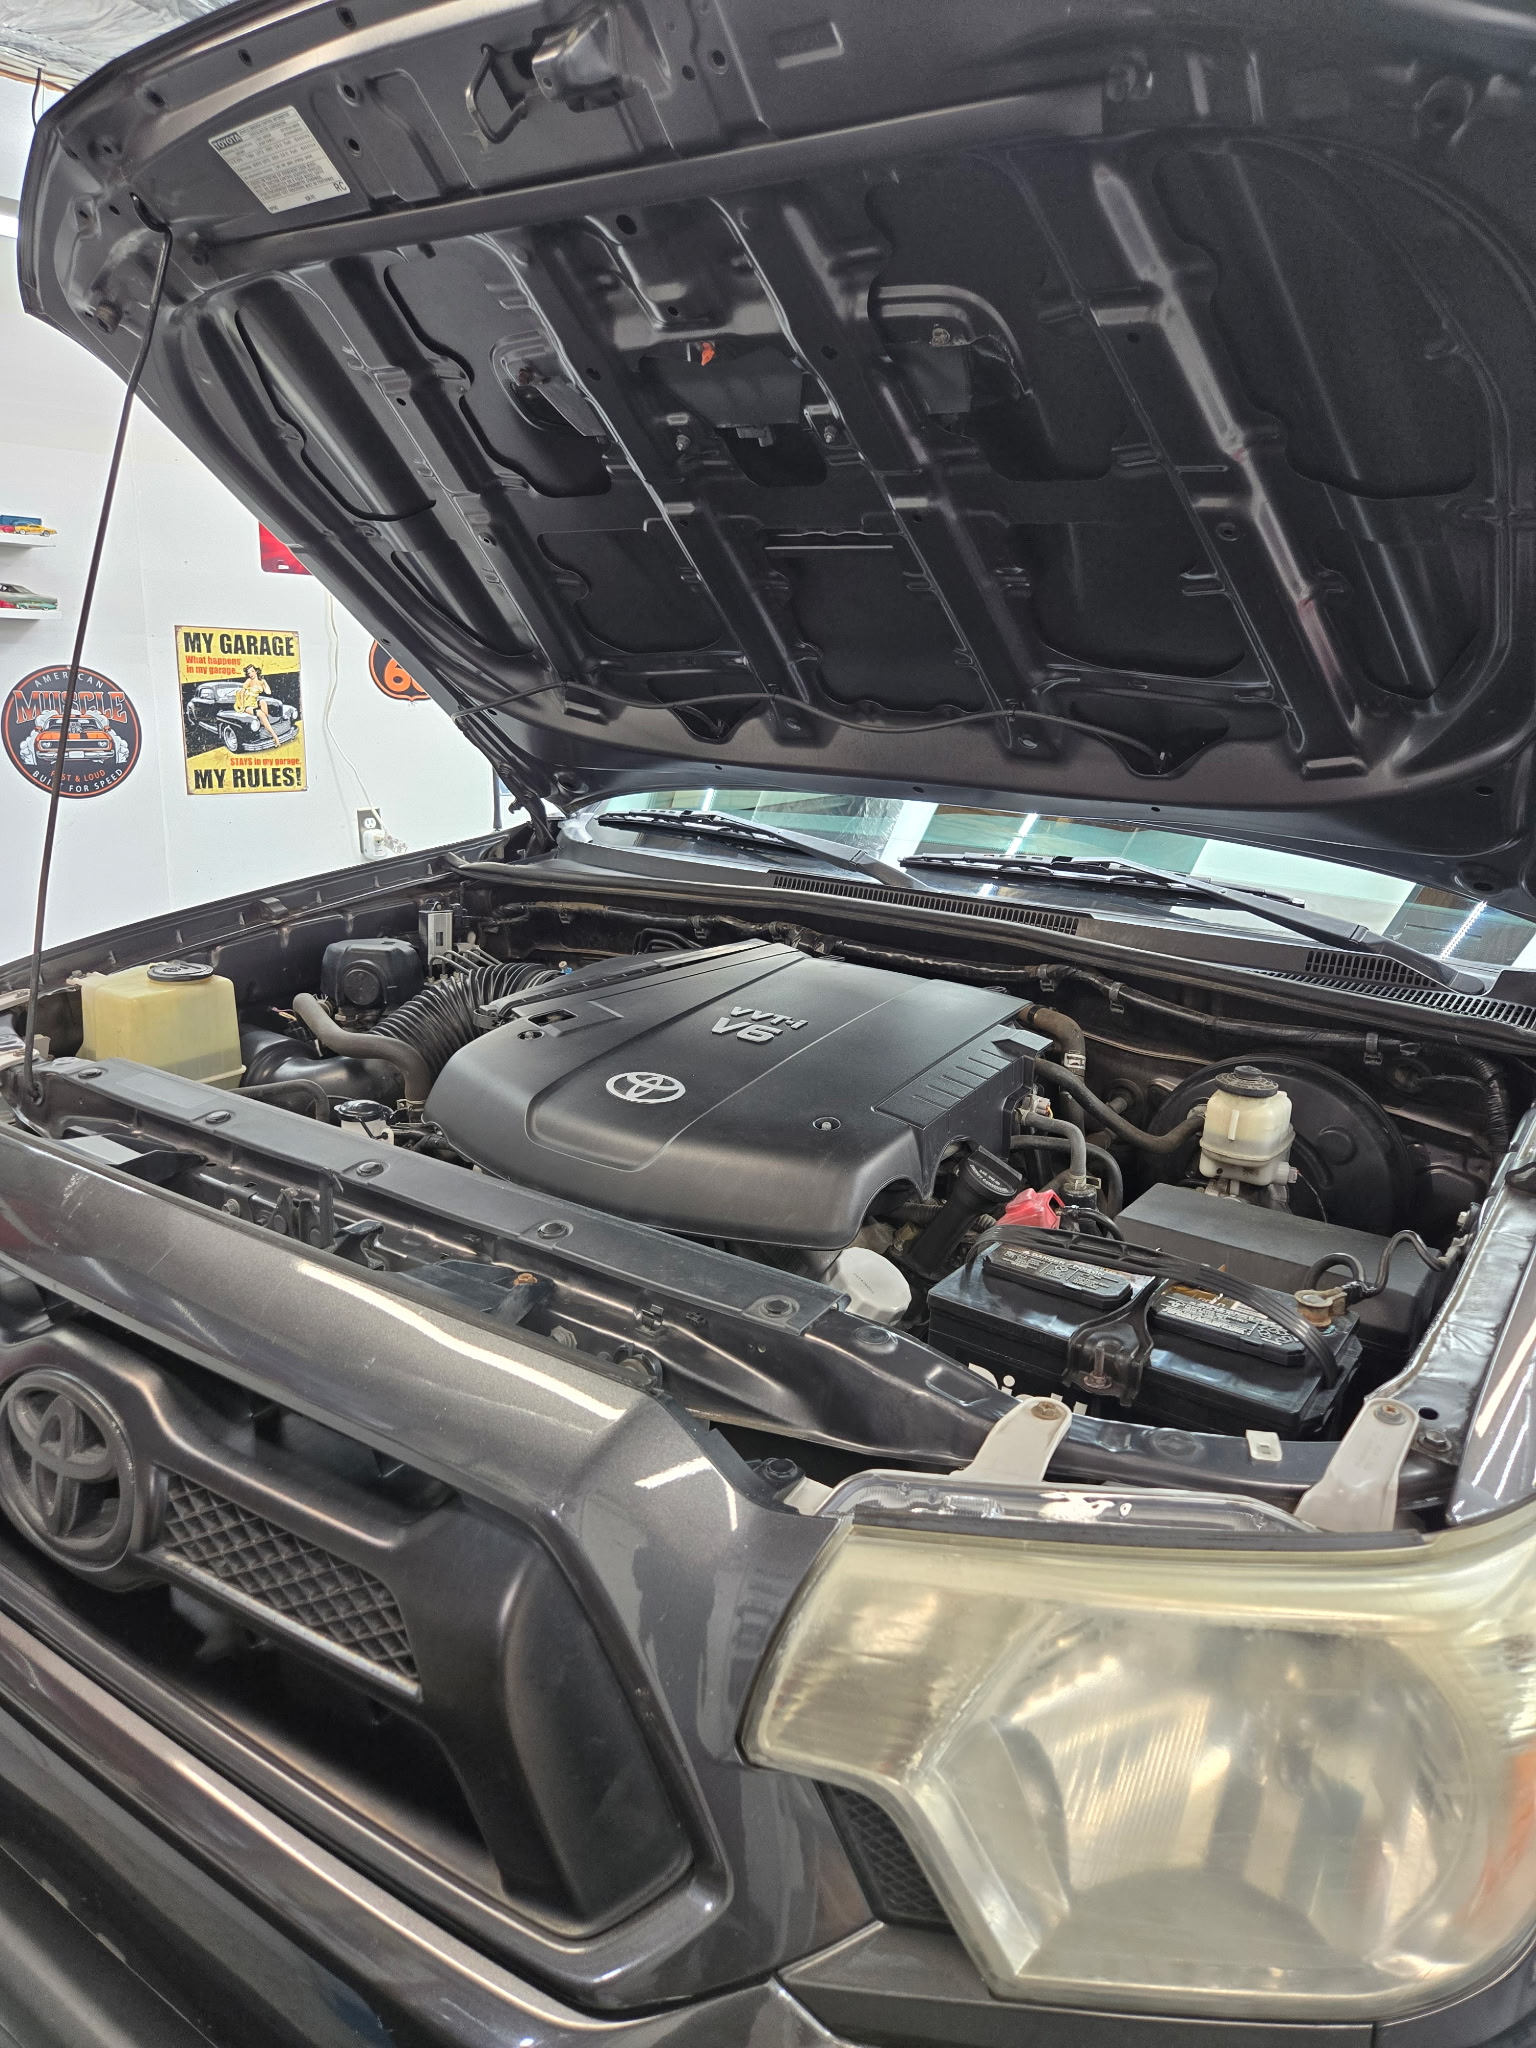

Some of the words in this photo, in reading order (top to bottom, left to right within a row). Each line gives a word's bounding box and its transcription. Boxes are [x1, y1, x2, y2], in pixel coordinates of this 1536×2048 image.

[212, 134, 241, 150] TOYOTA
[333, 181, 347, 193] RC
[183, 631, 214, 654] MY
[219, 633, 295, 657] GARAGE
[185, 655, 207, 665] What
[208, 656, 241, 666] happens
[186, 665, 195, 674] in
[196, 666, 208, 675] my
[384, 658, 425, 693] 6
[34, 671, 104, 689] AMERCAN
[230, 757, 253, 766] STAYS
[254, 757, 262, 766] in
[262, 758, 274, 767] my
[32, 770, 64, 787] BUI
[69, 784, 90, 793] FOR
[94, 769, 123, 790] SPEED
[50, 770, 72, 781] FST
[75, 775, 81, 783] &
[84, 769, 107, 782] LOUD
[193, 769, 227, 790] MY
[232, 767, 302, 788] RULES!
[711, 1016, 784, 1043] V6
[1031, 1252, 1065, 1266] DANGER
[1072, 1264, 1107, 1278] POISON
